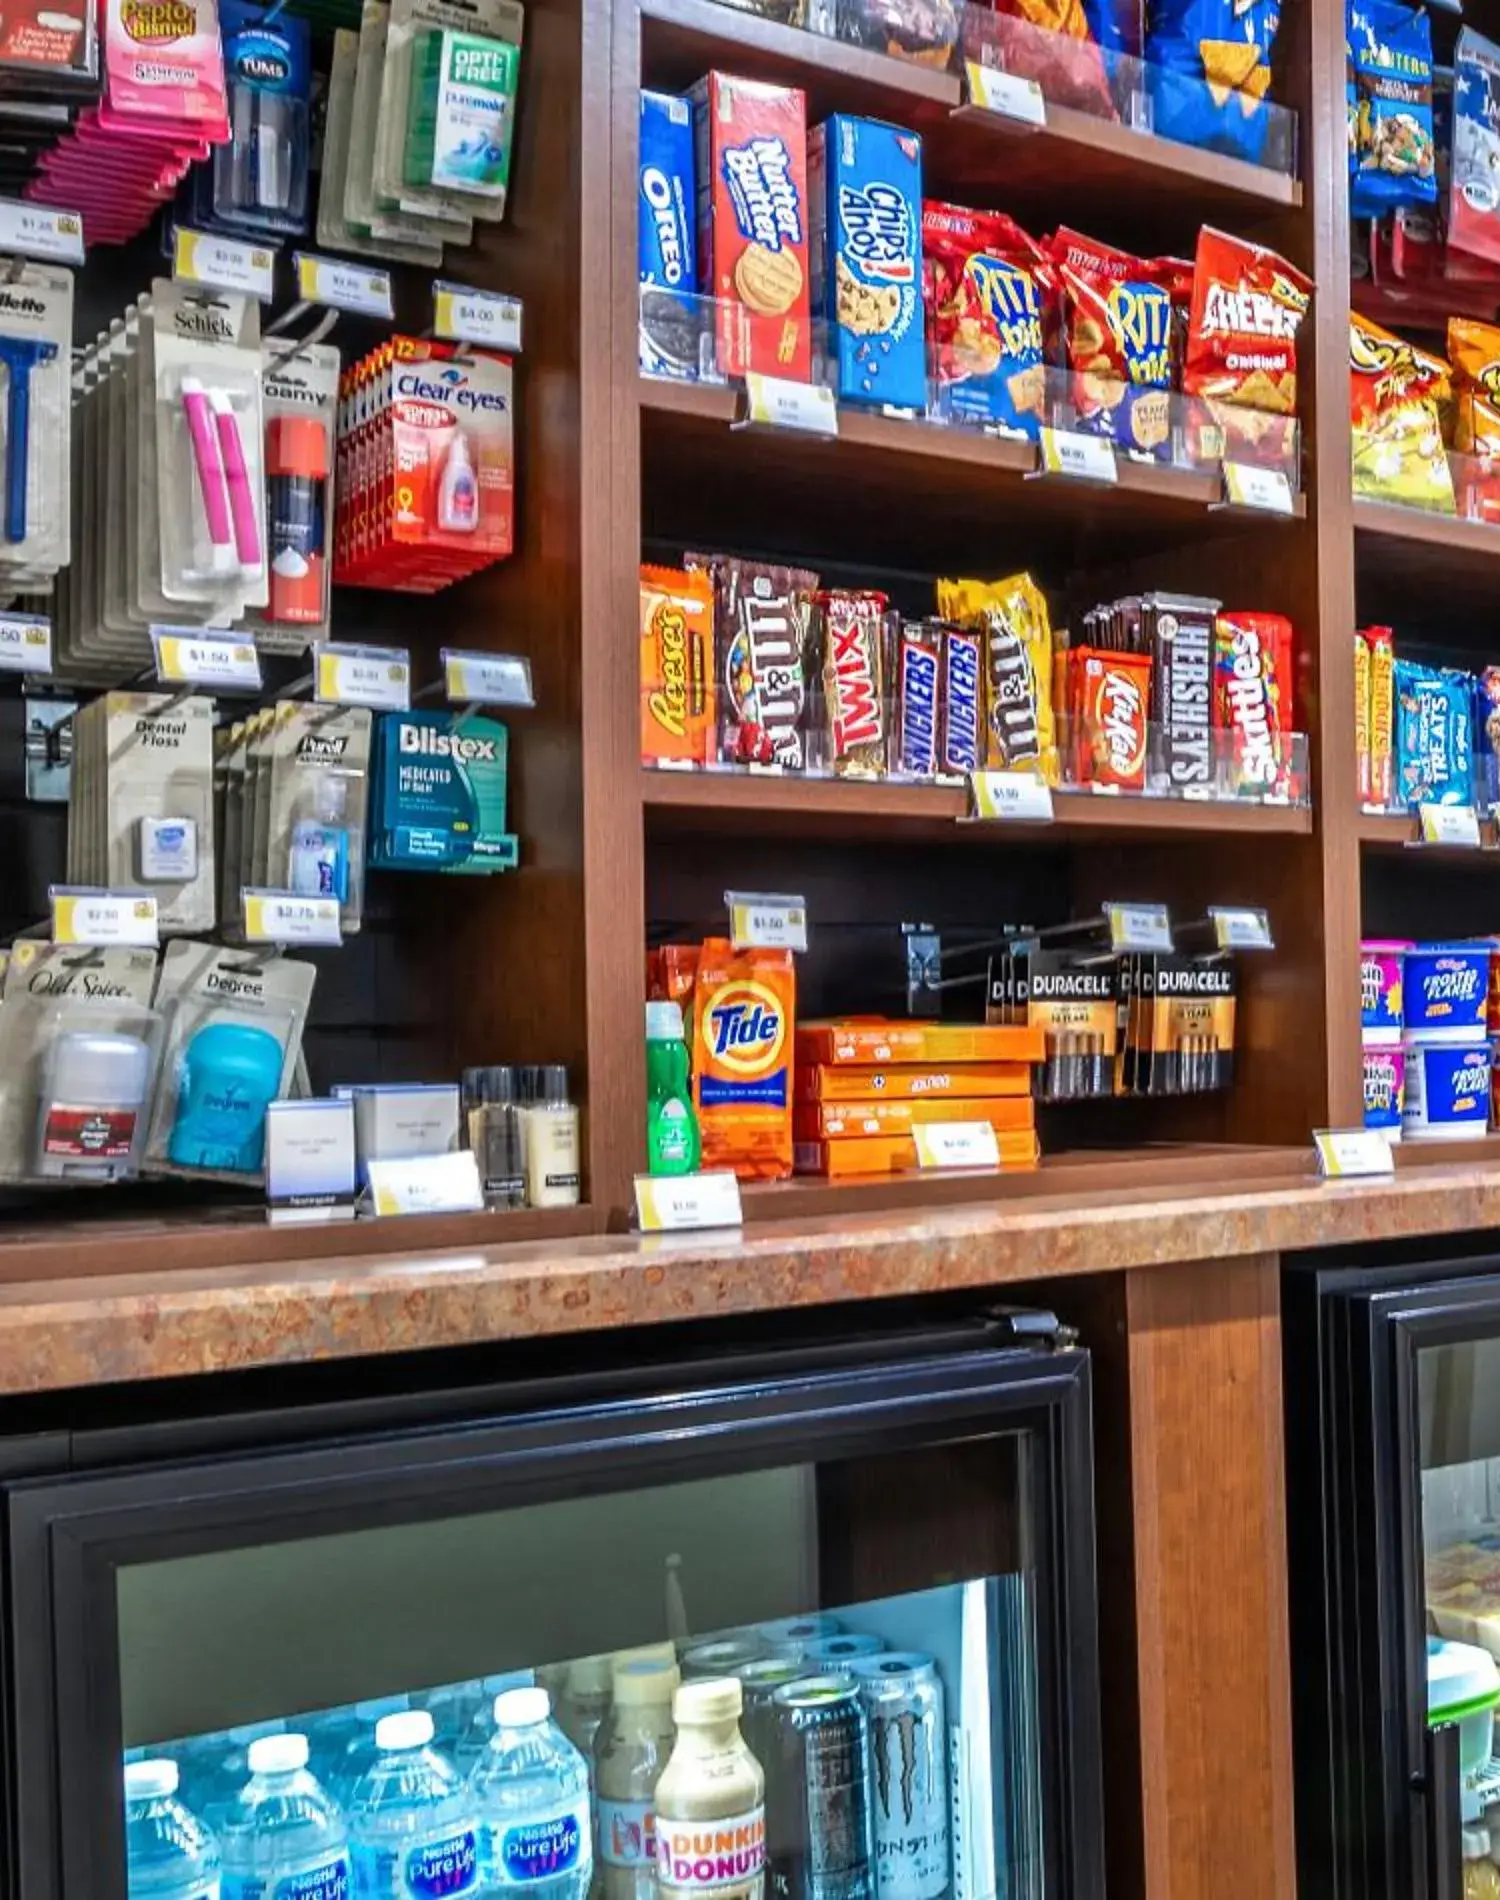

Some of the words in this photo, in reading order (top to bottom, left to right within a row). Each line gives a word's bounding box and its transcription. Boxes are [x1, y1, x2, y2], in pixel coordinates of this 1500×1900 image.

[243, 58, 284, 78] TUMS
[455, 65, 504, 82] FREE
[642, 166, 682, 286] OREO
[174, 307, 234, 338] Schick
[264, 384, 327, 406] oamy
[397, 374, 452, 403] Clear
[456, 389, 507, 414] eyes
[948, 636, 979, 769] SNICKERS
[134, 718, 187, 735] Dental
[142, 733, 181, 749] Floss
[399, 723, 497, 766] Blistex
[1430, 696, 1449, 783] TREATS
[399, 765, 452, 785] MEDICATED
[28, 971, 70, 997] Old
[78, 972, 125, 999] Spice
[207, 973, 263, 998] Degree
[1033, 975, 1110, 996] DURACELL
[1158, 971, 1231, 992] DURACELL
[711, 1003, 779, 1057] Tide
[507, 1842, 551, 1860] Pure
[409, 1859, 455, 1881] Pure
